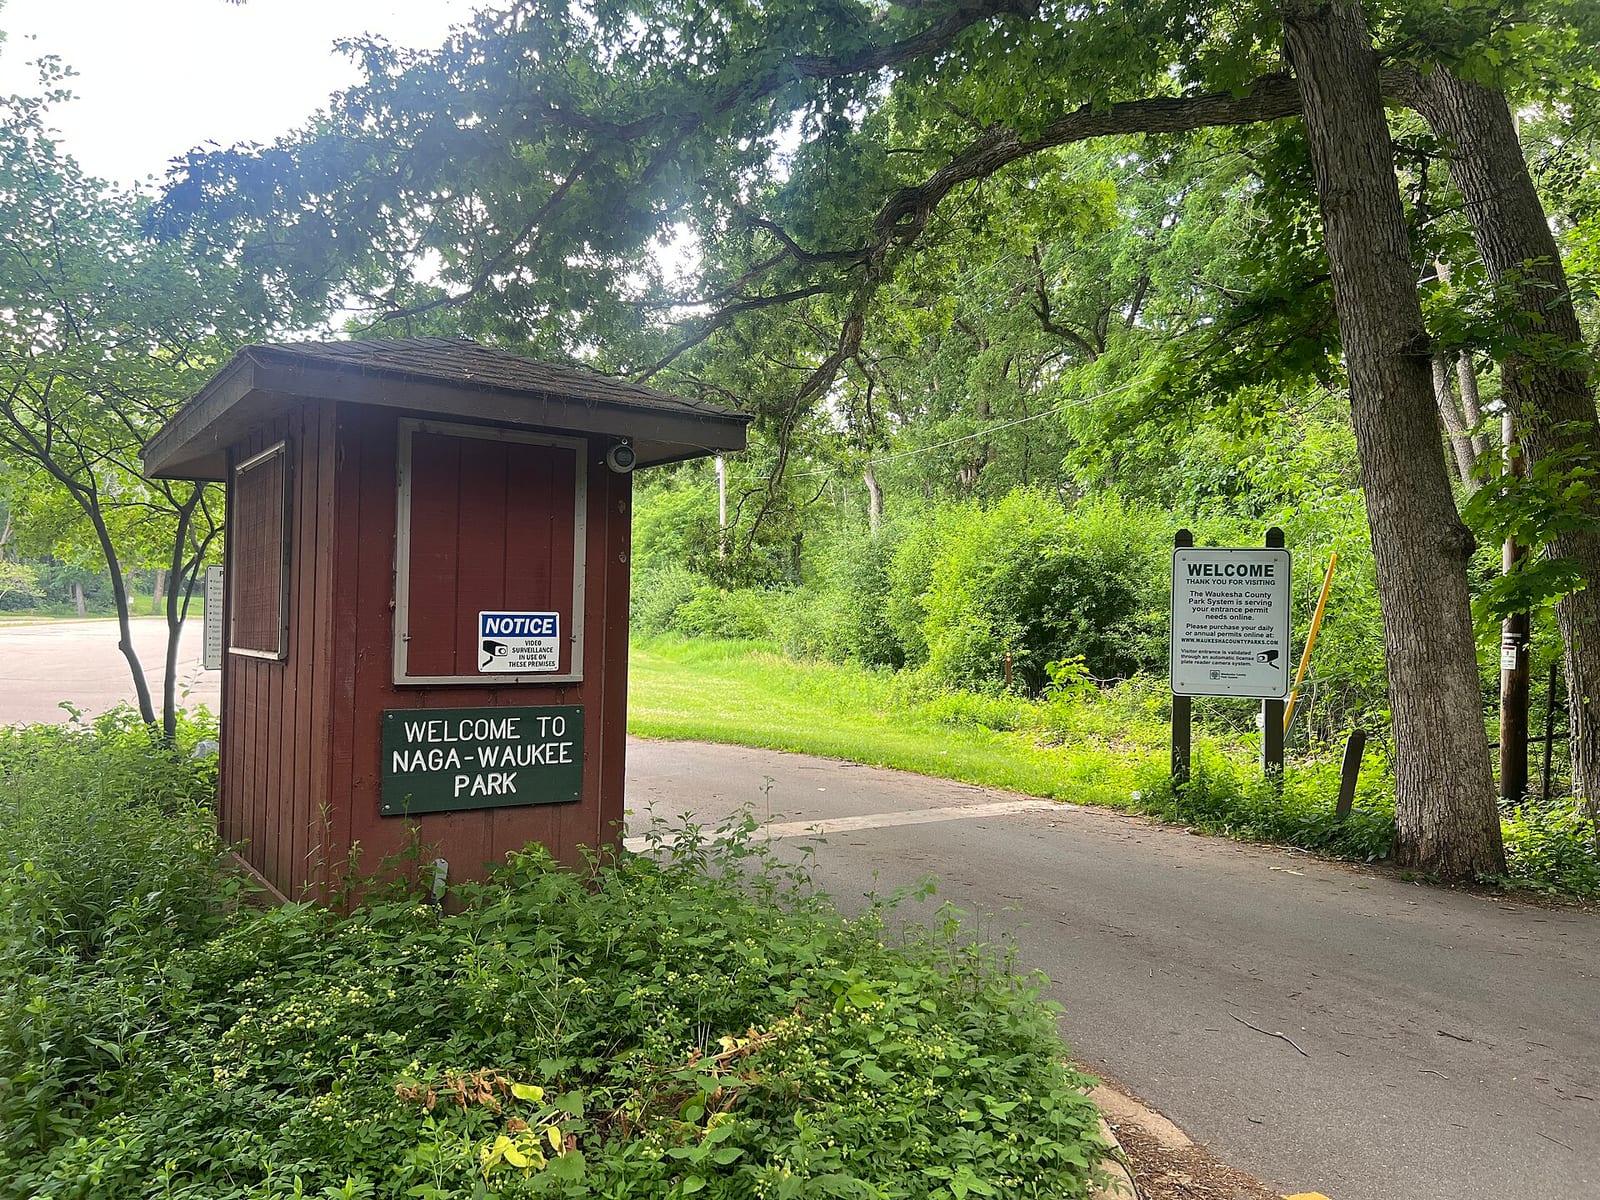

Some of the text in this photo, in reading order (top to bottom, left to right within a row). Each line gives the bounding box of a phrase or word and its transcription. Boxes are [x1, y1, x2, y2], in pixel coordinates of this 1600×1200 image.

[1187, 563, 1274, 577] WELCOME
[1205, 590, 1243, 598] Waukesha
[1244, 591, 1272, 599] County
[1207, 598, 1234, 606] System
[1244, 599, 1273, 607] serving
[1244, 606, 1268, 614] permit
[1229, 613, 1255, 621] online.
[485, 617, 554, 634] NOTICE
[1209, 623, 1240, 631] purchase
[1240, 624, 1257, 632] your
[1257, 624, 1274, 632] daily
[511, 646, 553, 654] SURVEILLANCE
[404, 716, 566, 743] WELCOME TO
[392, 742, 573, 773] NAGA-WAUKEE
[454, 771, 518, 798] PARK
